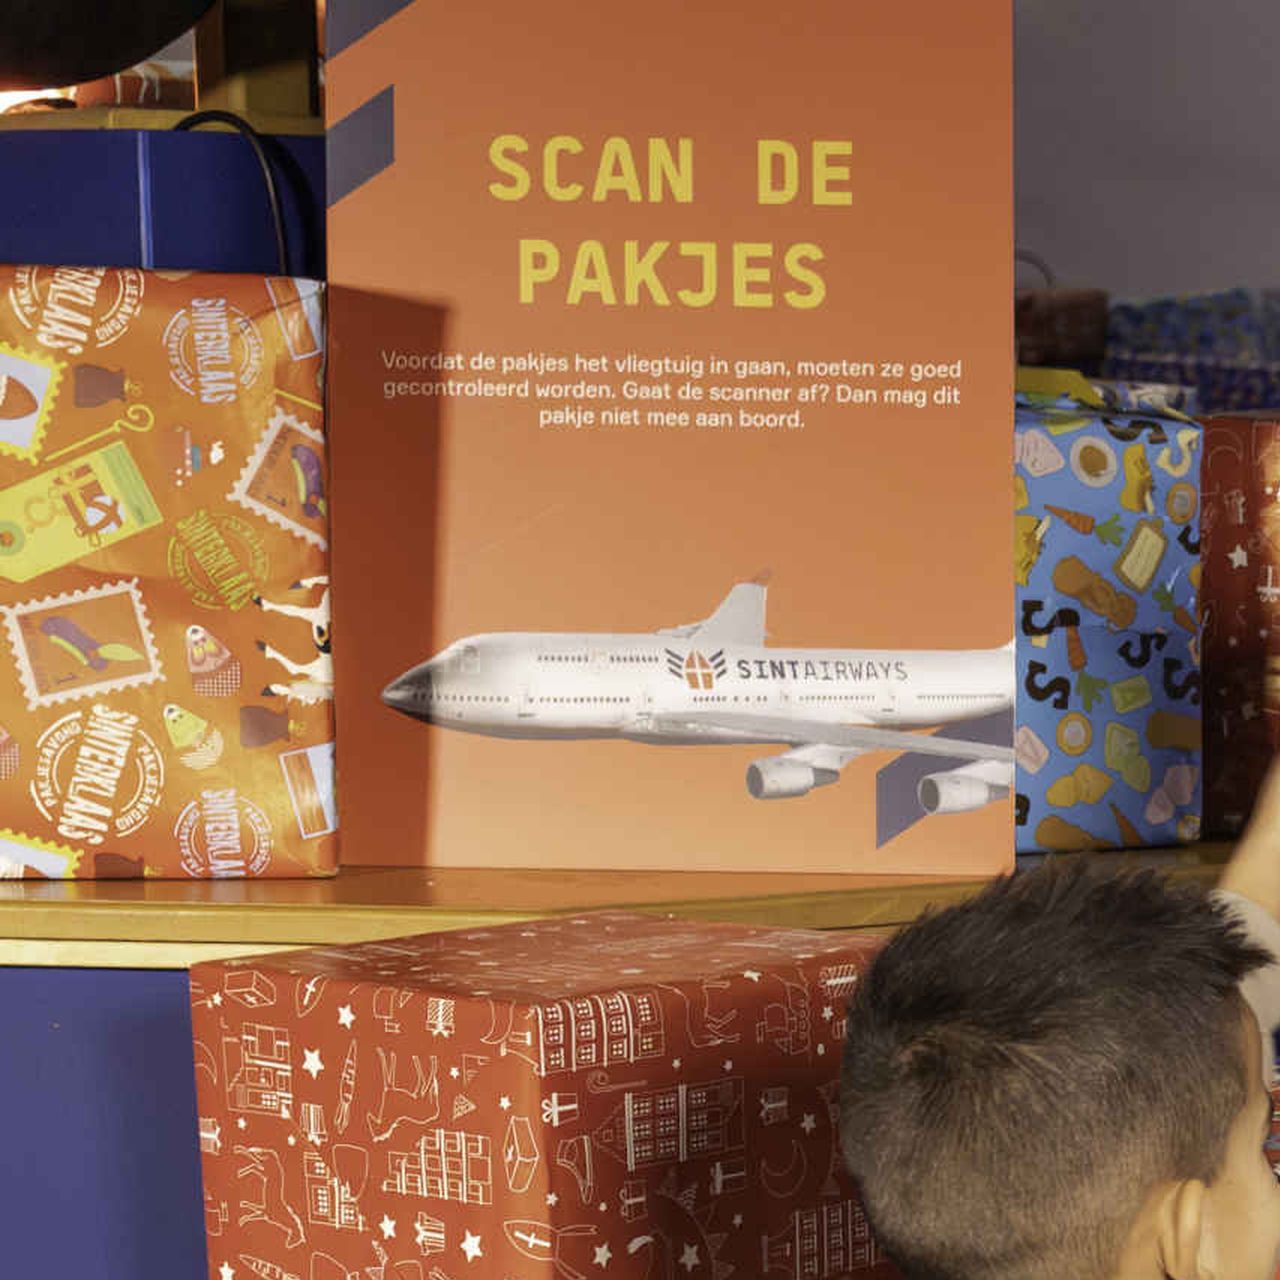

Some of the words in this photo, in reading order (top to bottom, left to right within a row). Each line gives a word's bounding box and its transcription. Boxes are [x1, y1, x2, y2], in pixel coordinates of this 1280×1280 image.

[491, 136, 692, 202] SCAN
[758, 139, 853, 205] DE
[519, 239, 826, 308] PAKJES
[382, 350, 464, 370] Voordat
[470, 352, 495, 370] de
[502, 352, 569, 375] pakjes
[575, 353, 608, 372] het
[615, 353, 705, 377] vliegtuig
[710, 355, 728, 374] in
[734, 360, 791, 380] gaan,
[797, 359, 875, 377] moeten
[881, 362, 904, 377] ze
[910, 360, 962, 382] goed
[383, 378, 529, 398] gecontroleerd
[536, 380, 616, 399] worden.
[623, 381, 671, 399] Gaat
[678, 382, 703, 400] de
[709, 384, 792, 403] scanner
[797, 383, 830, 403] af?
[836, 384, 877, 404] Dan
[884, 388, 927, 408] mag
[933, 385, 961, 405] dit
[540, 405, 594, 428] pakje
[601, 406, 640, 425] niet
[647, 409, 690, 427] mee
[695, 411, 733, 428] aan
[739, 408, 805, 428] boord.
[737, 659, 908, 682] SINTAIRWAYS
[57, 703, 139, 844] SINTERKLAAS
